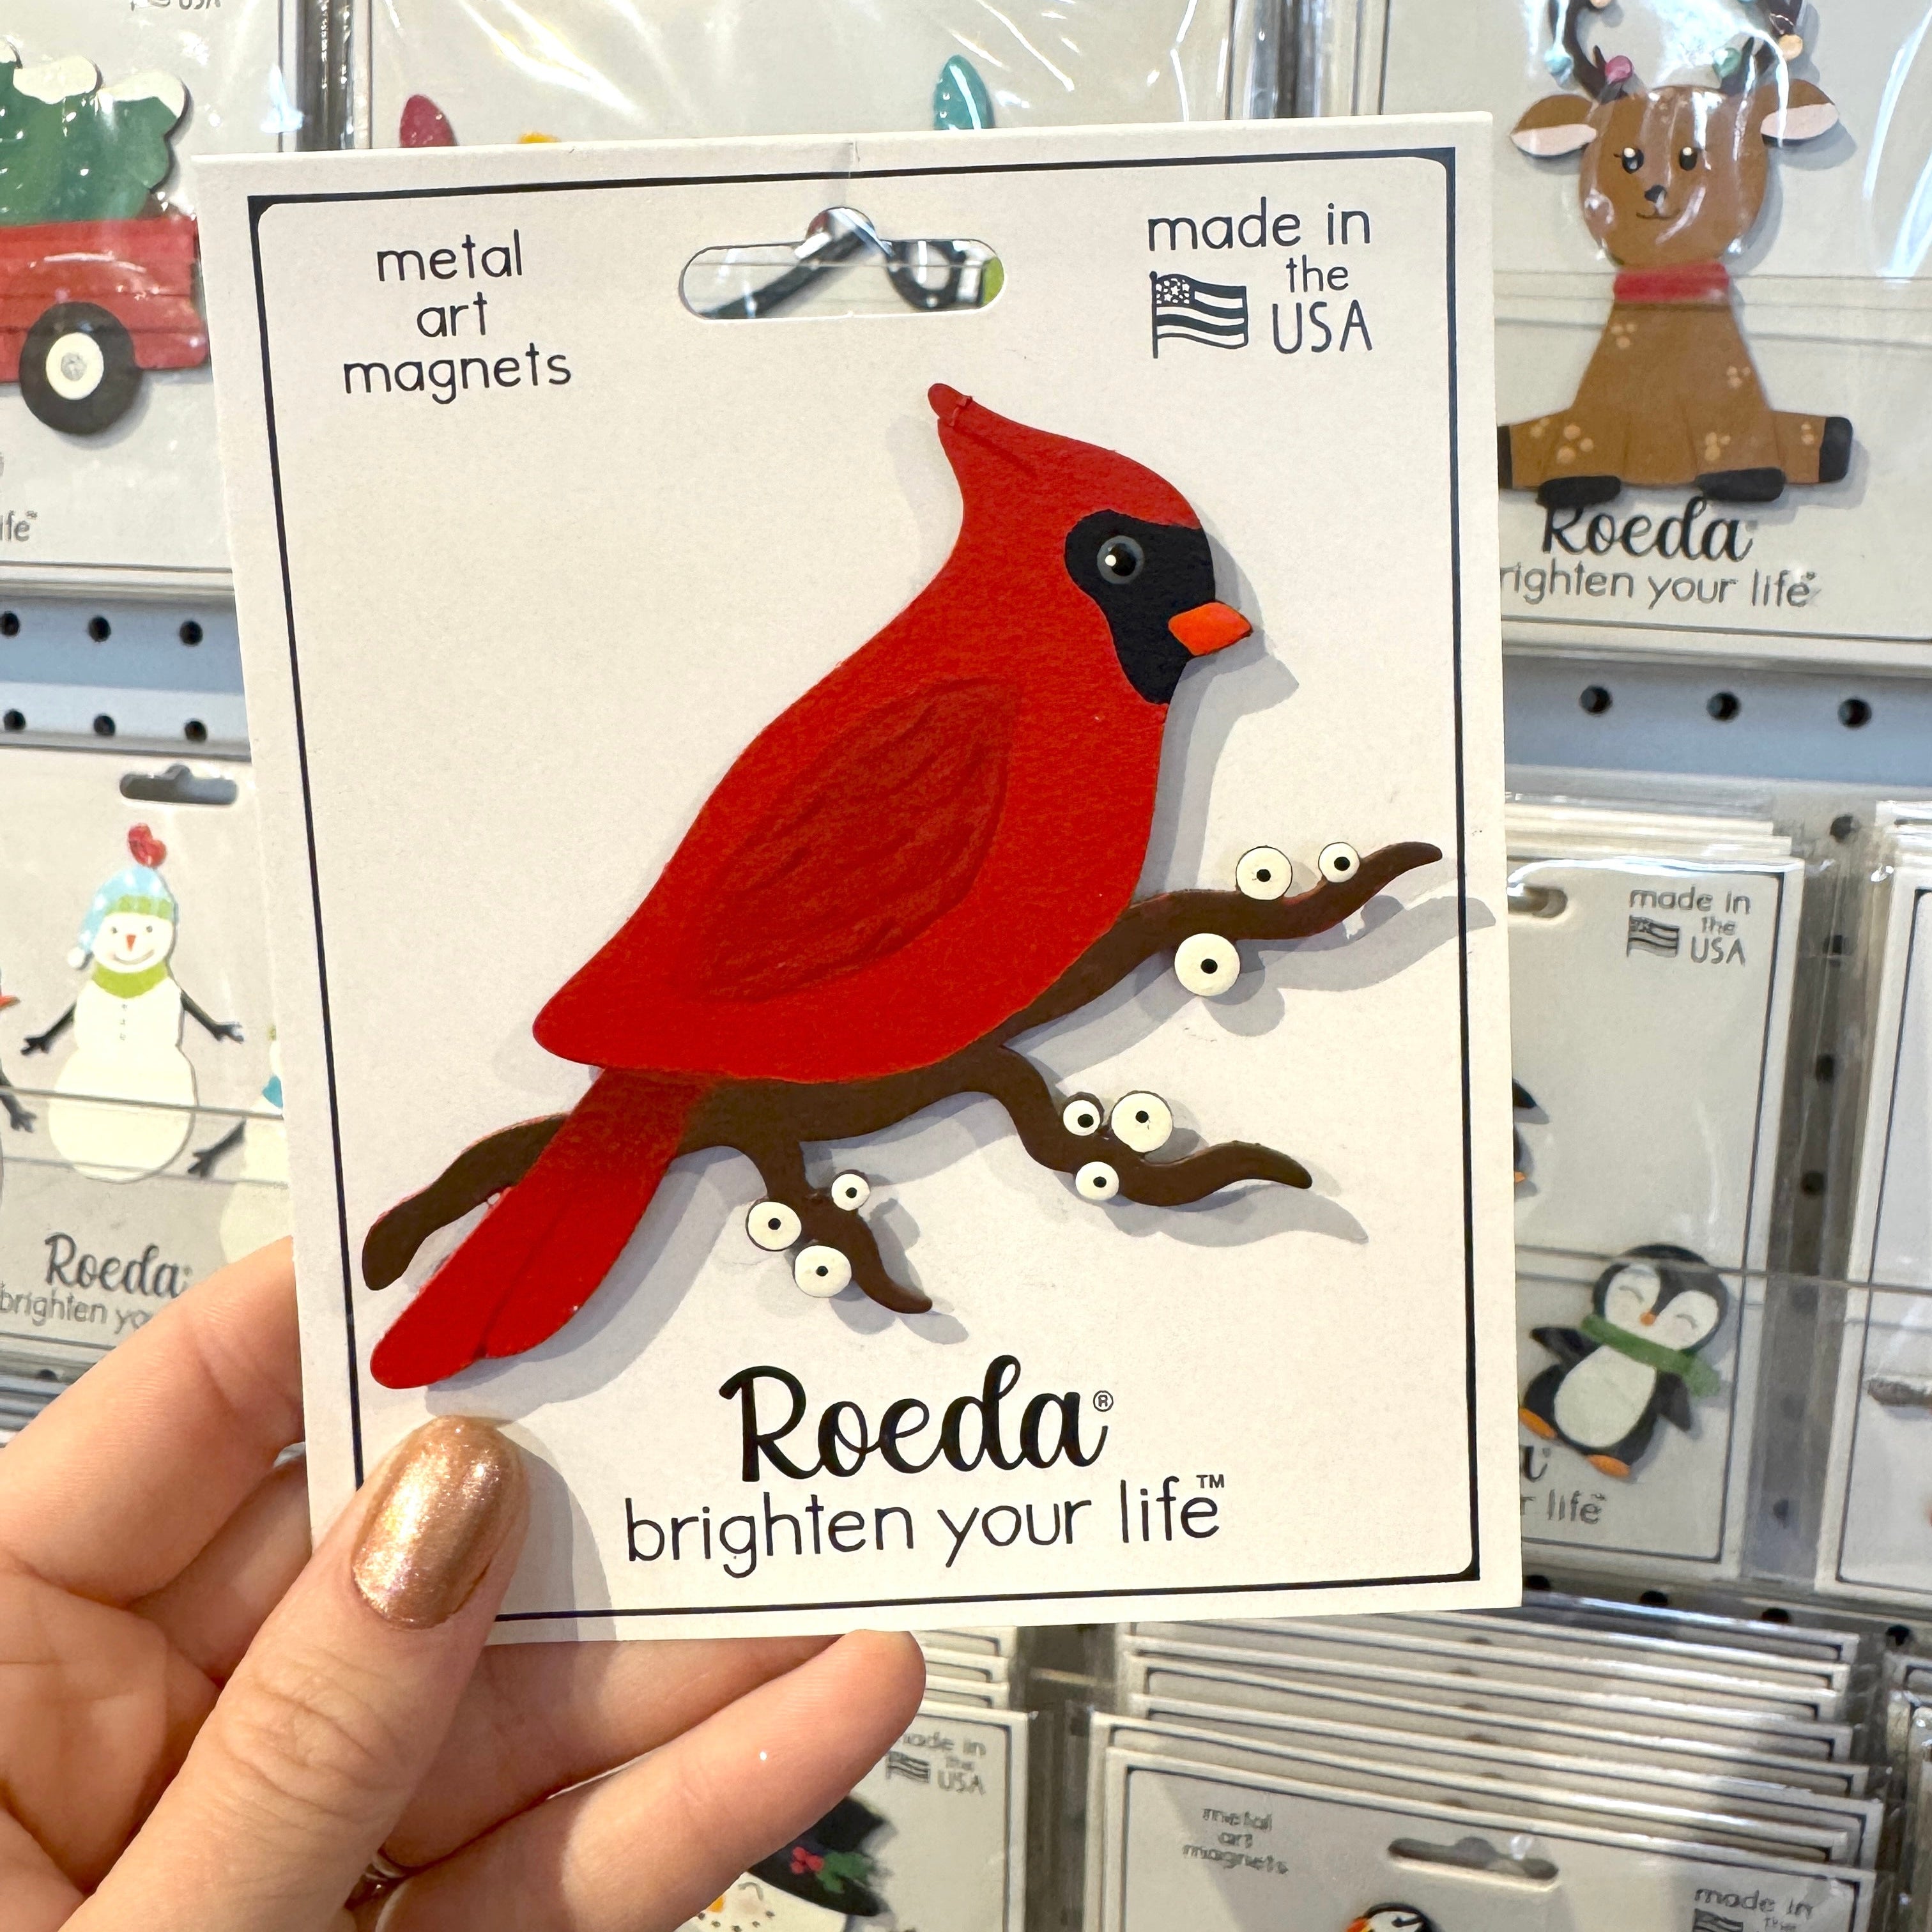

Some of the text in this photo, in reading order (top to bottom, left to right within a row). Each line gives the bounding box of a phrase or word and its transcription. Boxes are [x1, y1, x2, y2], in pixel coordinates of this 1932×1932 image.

[1148, 196, 1370, 251] made in
[377, 229, 523, 282] metal
[1285, 254, 1349, 293] the
[417, 291, 487, 337] art
[1272, 299, 1373, 354] USA
[343, 342, 572, 404] magnets
[1501, 558, 1633, 605] righten
[1648, 575, 1738, 610] your
[1630, 885, 1751, 915] made in
[1702, 916, 1736, 936] the
[1690, 936, 1745, 967] USA
[0, 1281, 107, 1326] brighten
[625, 1491, 913, 1577] brighten
[937, 1499, 1091, 1568] your
[902, 1731, 954, 1750] ade
[1694, 1889, 1774, 1912] made
